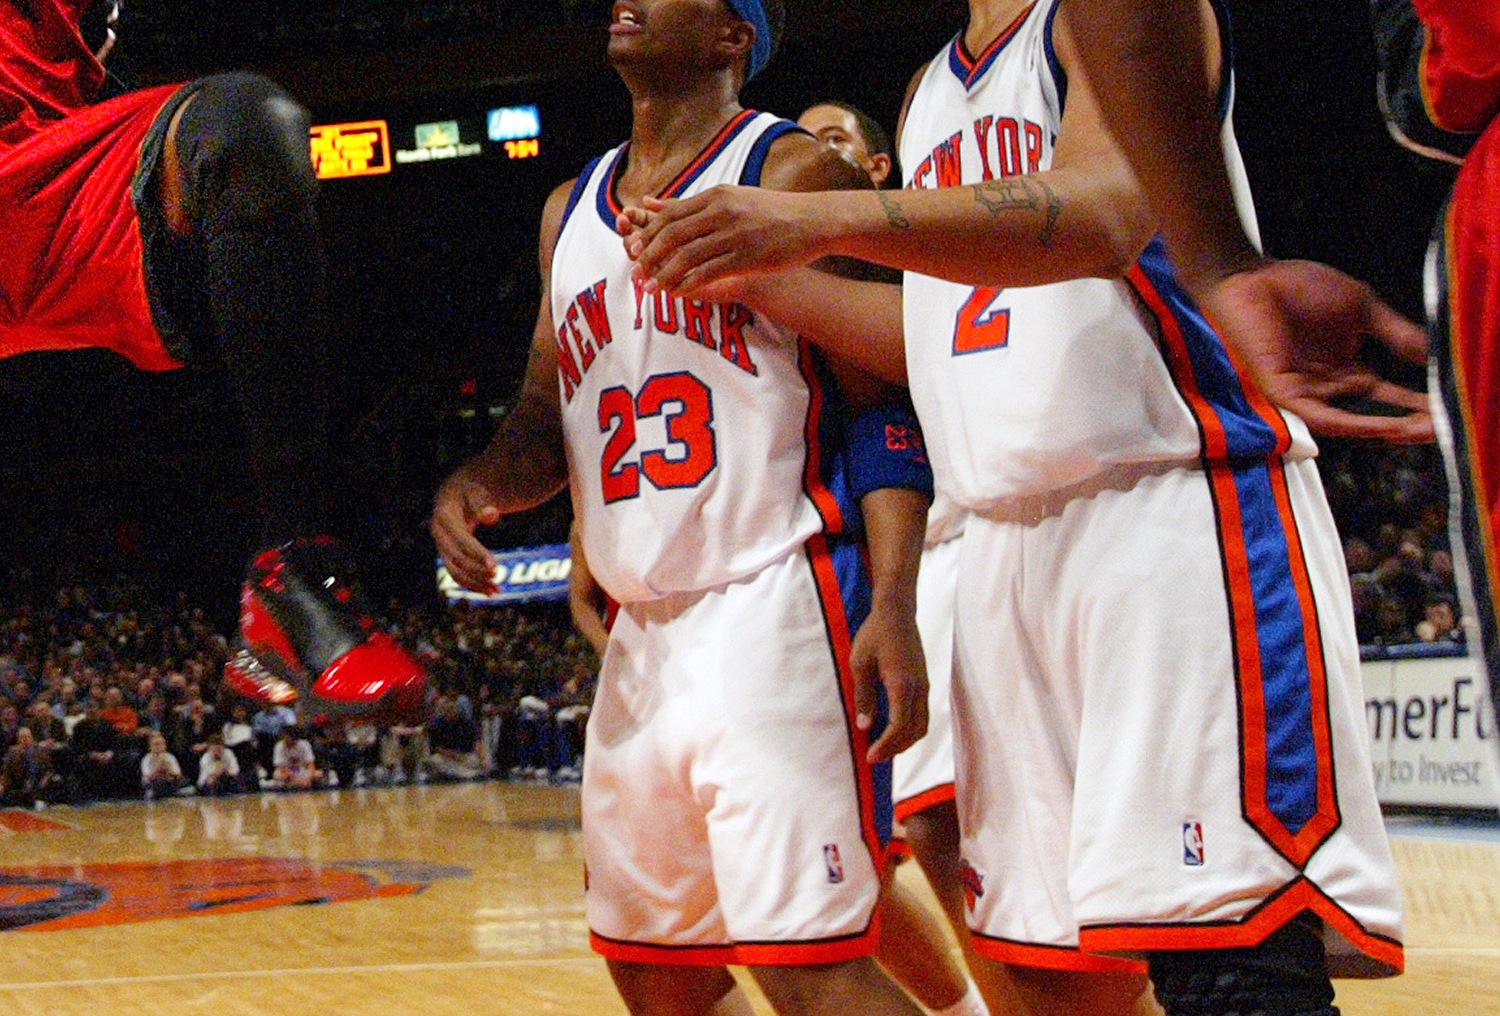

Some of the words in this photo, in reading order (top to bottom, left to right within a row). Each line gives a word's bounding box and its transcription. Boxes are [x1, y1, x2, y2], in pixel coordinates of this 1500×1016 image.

[905, 130, 963, 190] EW
[974, 114, 1050, 181] YOR
[556, 277, 613, 404] NEW
[597, 370, 718, 505] 23
[1389, 758, 1414, 783] to
[1418, 755, 1481, 785] Invest
